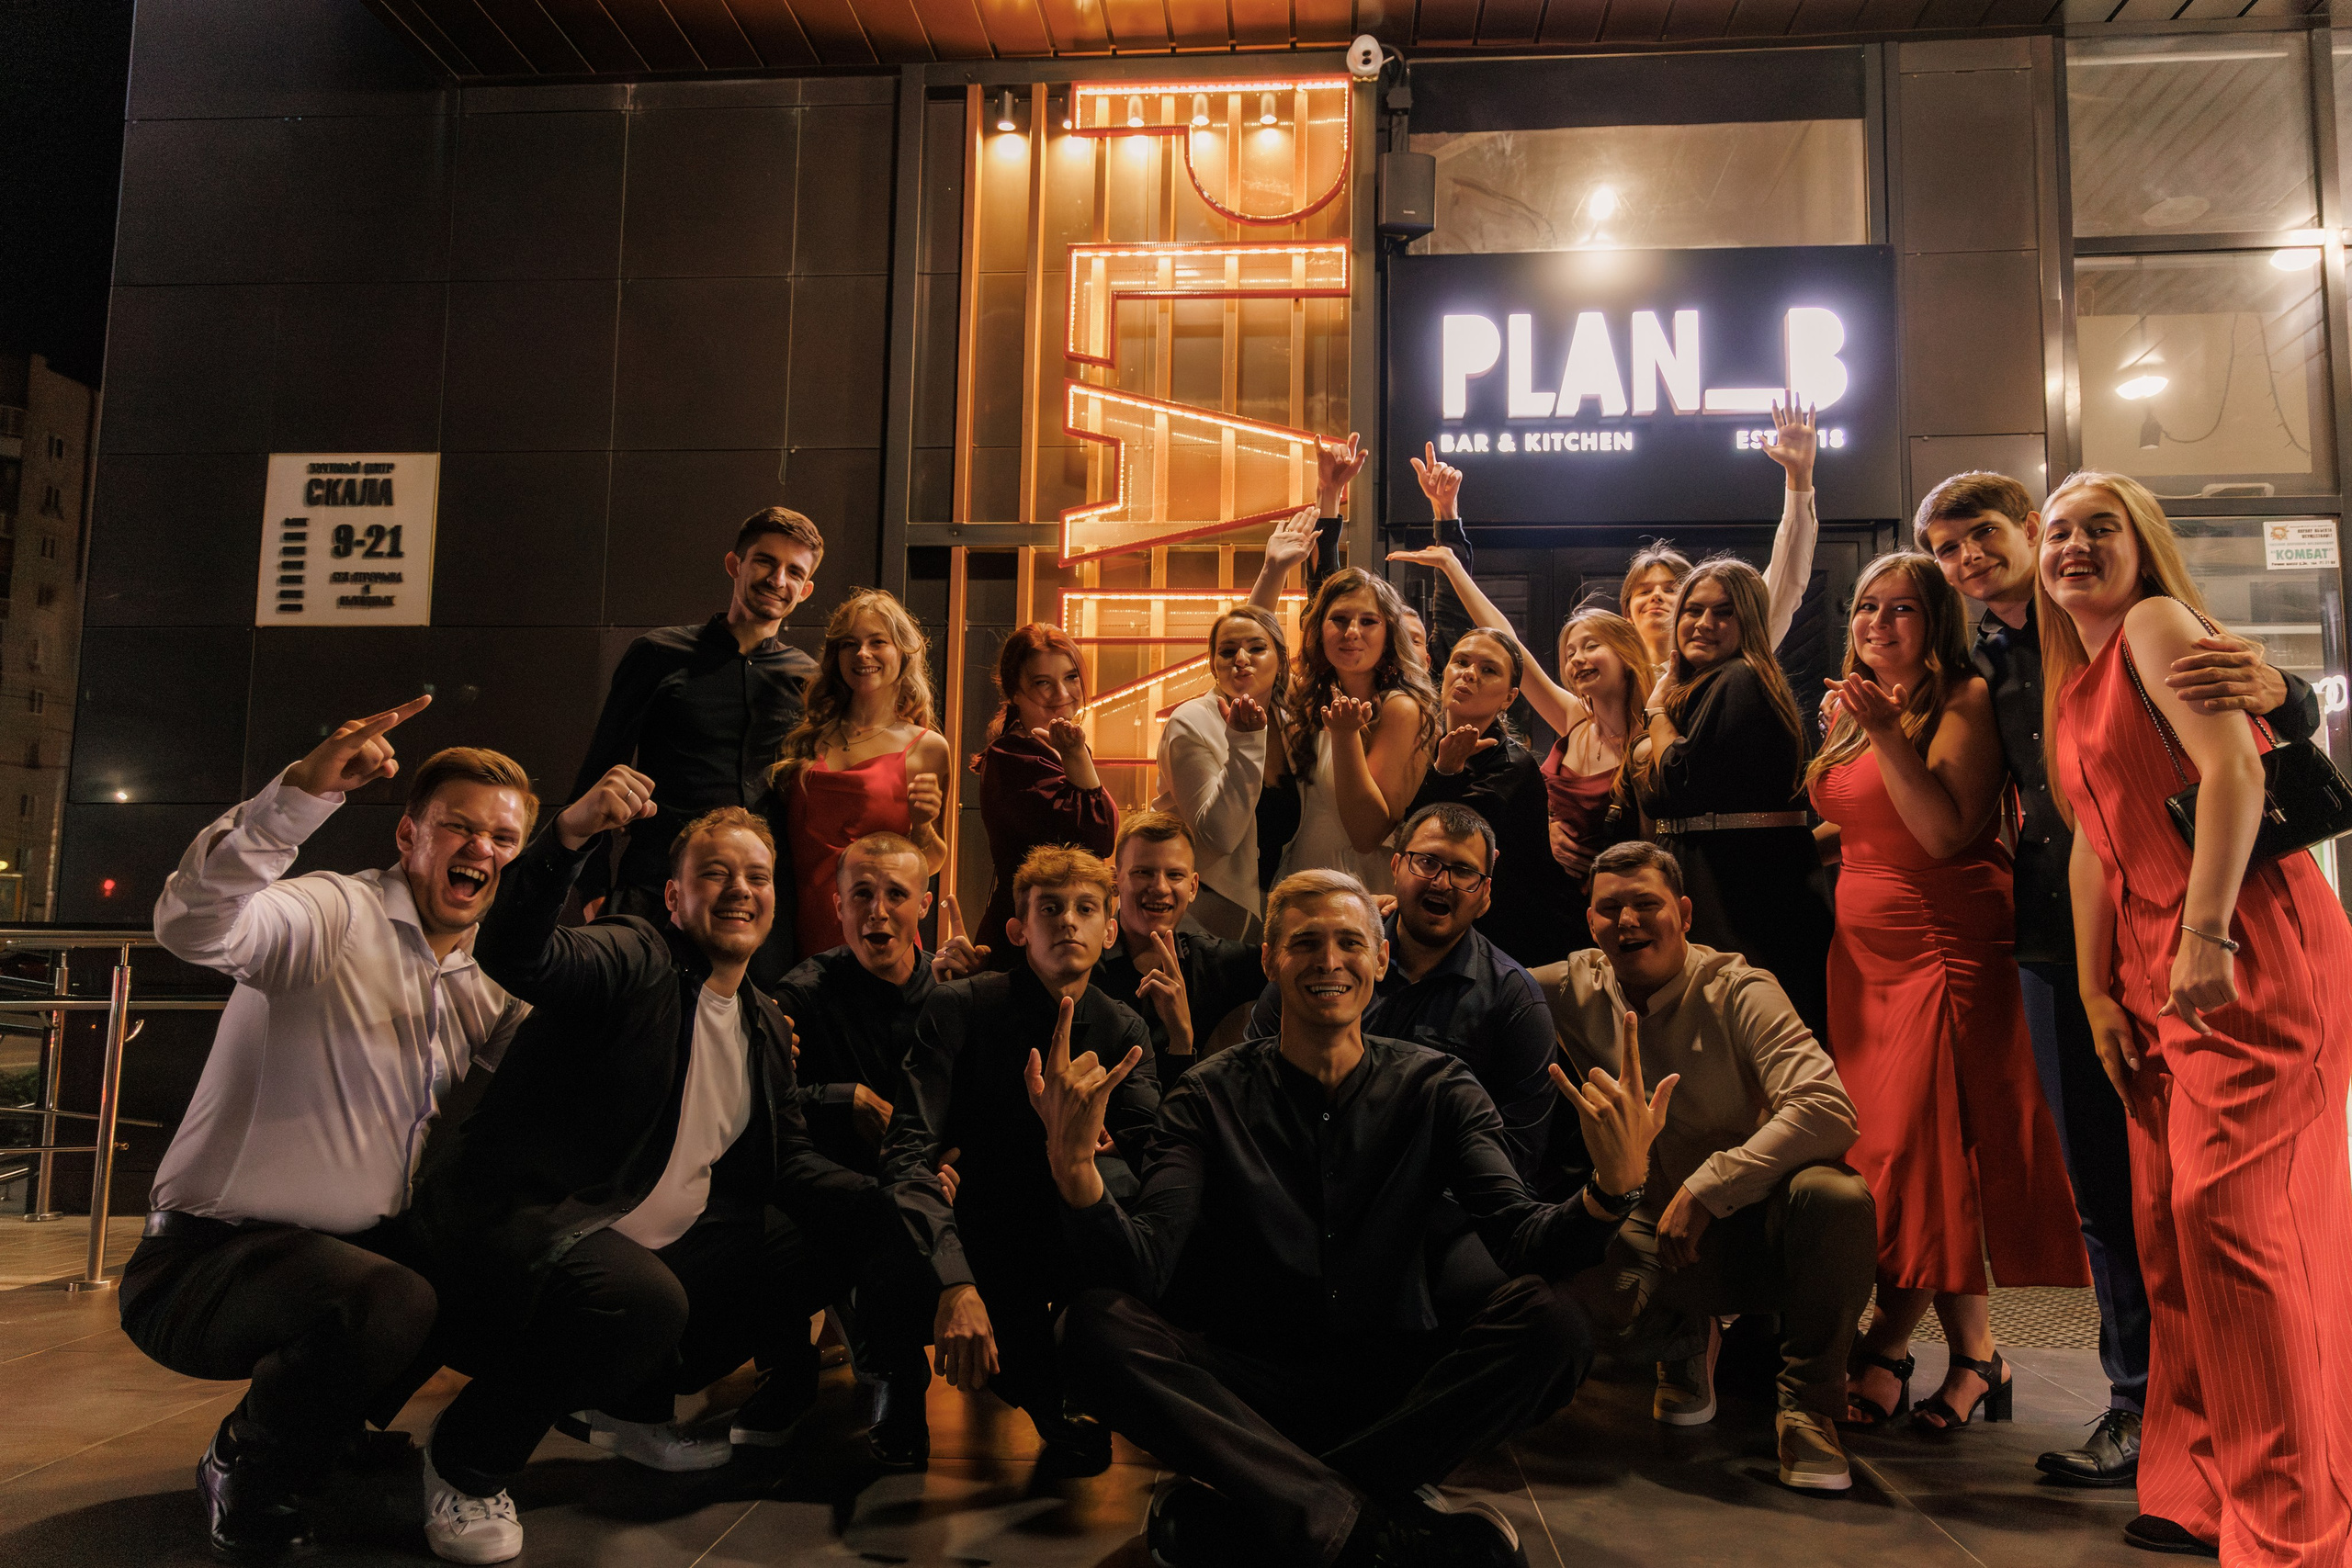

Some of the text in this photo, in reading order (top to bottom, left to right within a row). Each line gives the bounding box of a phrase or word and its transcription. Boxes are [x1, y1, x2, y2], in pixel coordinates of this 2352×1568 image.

[1440, 431, 1634, 453] BAR & KITCHEN
[305, 478, 394, 506] СКАЛА
[332, 524, 404, 558] 9-21
